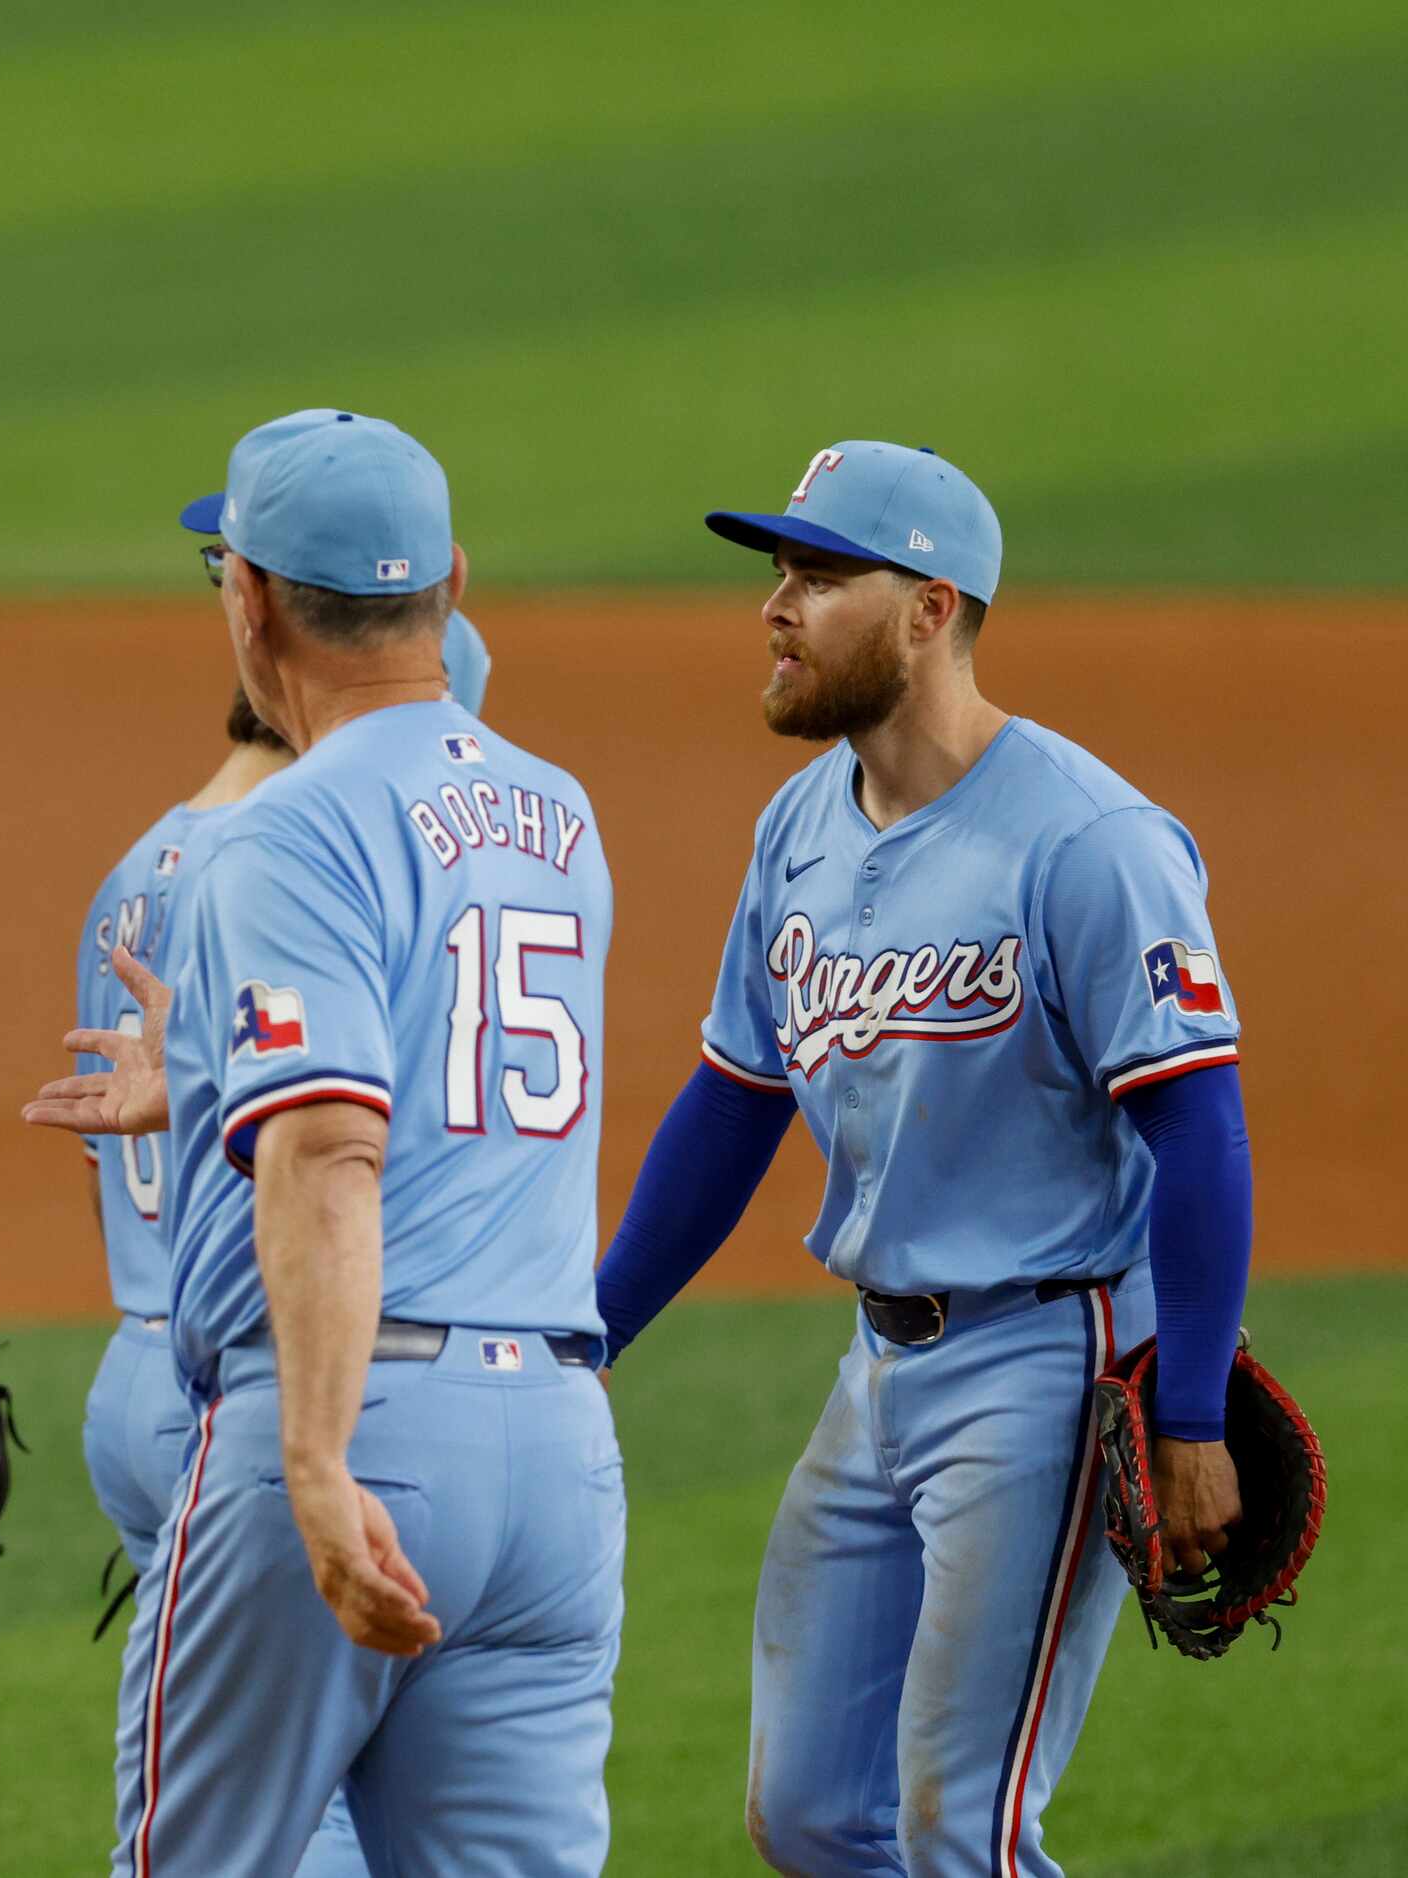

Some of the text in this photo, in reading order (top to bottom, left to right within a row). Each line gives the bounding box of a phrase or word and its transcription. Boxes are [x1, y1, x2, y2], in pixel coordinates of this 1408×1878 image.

[792, 448, 844, 504] T
[408, 779, 584, 875] BOCHY
[443, 904, 589, 1140] 15
[767, 911, 1024, 1062] Rangers
